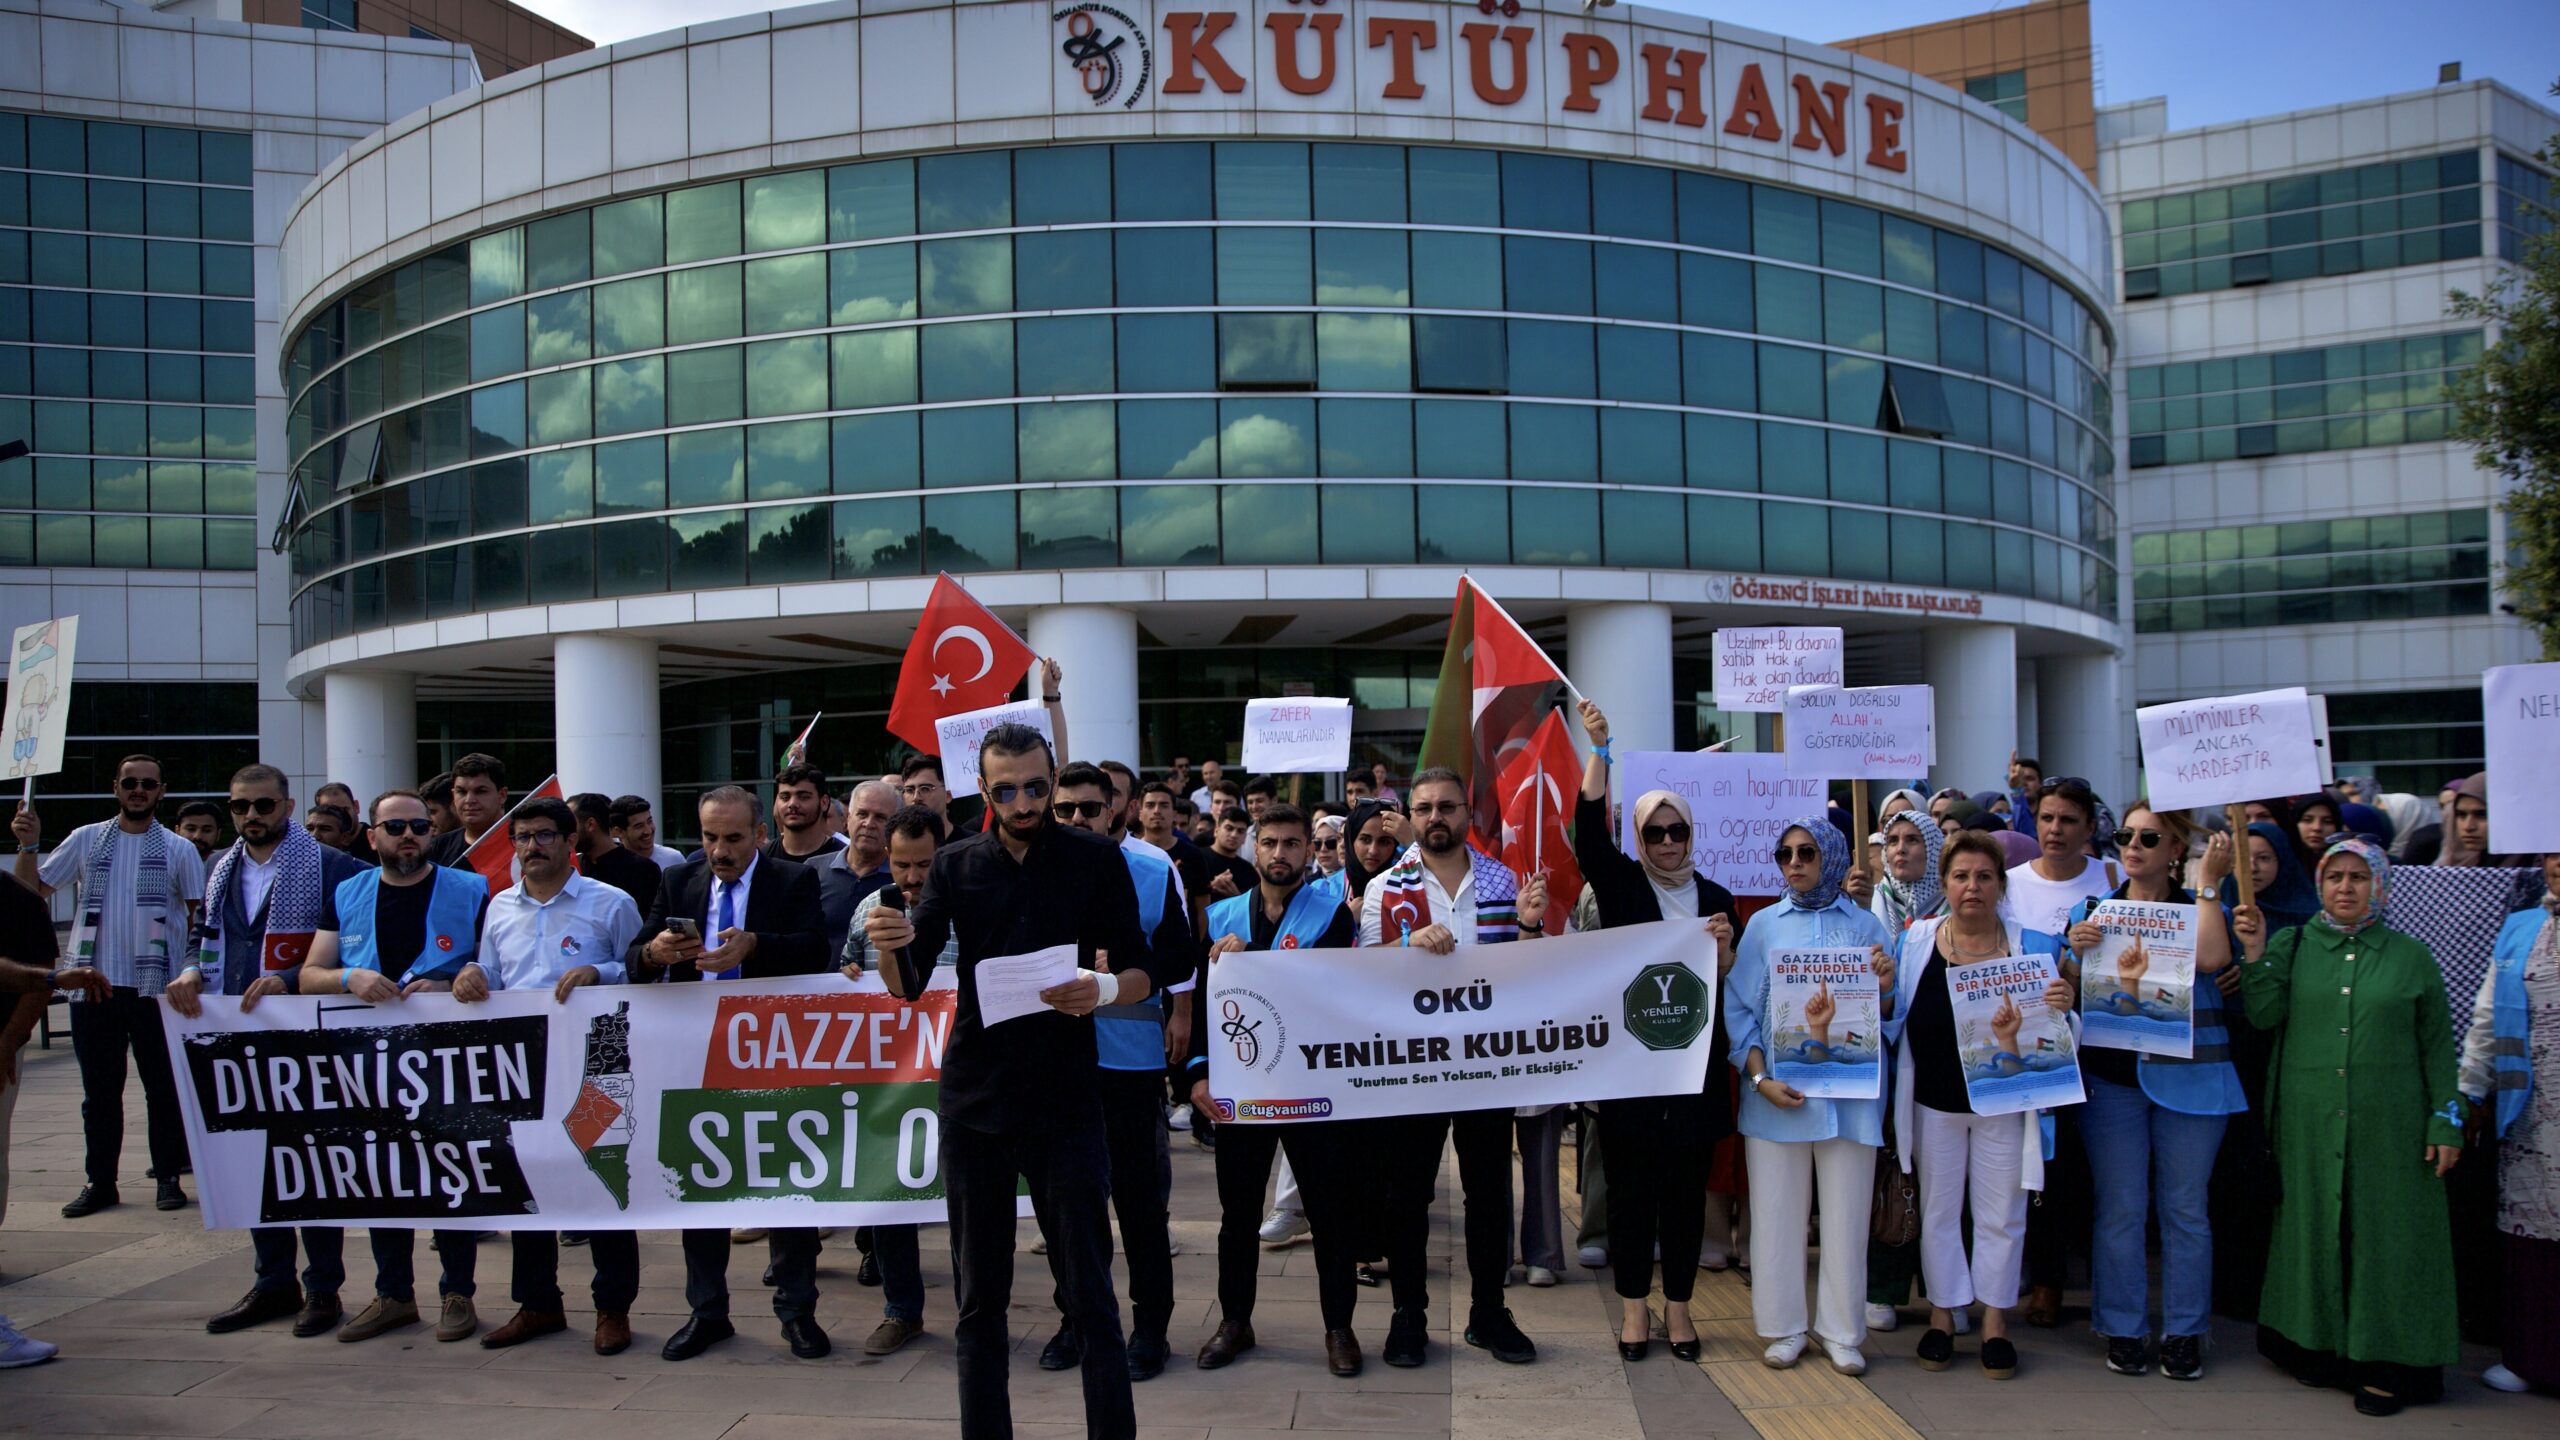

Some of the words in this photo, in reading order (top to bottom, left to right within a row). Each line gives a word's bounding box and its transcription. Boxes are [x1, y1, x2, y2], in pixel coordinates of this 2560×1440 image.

[1162, 0, 1907, 173] KÜTÜPHANE
[1732, 576, 1808, 602] ÖĞRENCİ
[1812, 581, 1859, 608] İŞLERİ
[1863, 586, 1903, 608] DAİRE
[1906, 591, 1982, 616] BAŞKANLIĞI
[1727, 630, 1774, 650] Üzülme!
[1778, 630, 1791, 650] Bu
[1733, 671, 1758, 687] Hak
[1765, 670, 1792, 685] olan
[1795, 664, 1839, 684] davada
[1745, 688, 1780, 705] zafer
[1270, 706, 1313, 722] ZAFER
[979, 717, 994, 730] EN
[2192, 733, 2254, 754] ANCAK
[2177, 750, 2273, 784] KARDEŞTİR
[1713, 780, 1732, 797] en
[2099, 905, 2146, 917] GAZZE
[2117, 916, 2187, 931] KURDELE
[2127, 927, 2176, 940] UMUT!
[1782, 954, 1830, 964] GAZZE
[1803, 963, 1868, 974] KURDELE
[1959, 964, 2009, 981] GAZZE
[1813, 974, 1860, 984] UMUT!
[1983, 969, 2049, 988] KURDELE
[1214, 986, 1249, 1000] OSMANİYE
[1413, 978, 1493, 1015] OKÜ
[1653, 974, 1676, 1005] Y
[1994, 980, 2043, 997] UMUT!
[1248, 990, 1276, 1012] KORKUT
[1272, 1011, 1283, 1026] ATA
[1641, 1005, 1689, 1018] YENİLER
[1264, 1026, 1286, 1074] ÜNİVERSİTESİ
[1298, 1032, 1453, 1070] YENİLER
[1463, 1014, 1610, 1060] KULÜBÜ
[212, 1038, 532, 1121] DİRENİŞTEN
[1348, 1076, 1408, 1089] "Unutma
[1412, 1073, 1438, 1085] Sen
[1442, 1069, 1497, 1082] Yoksan,
[1501, 1065, 1522, 1077] Bir
[1526, 1059, 1584, 1075] Eksiğiz."
[1239, 1101, 1331, 1118] @tugvauni80
[688, 1090, 860, 1189] SESİ
[272, 1130, 503, 1209] DİRİLİŞE
